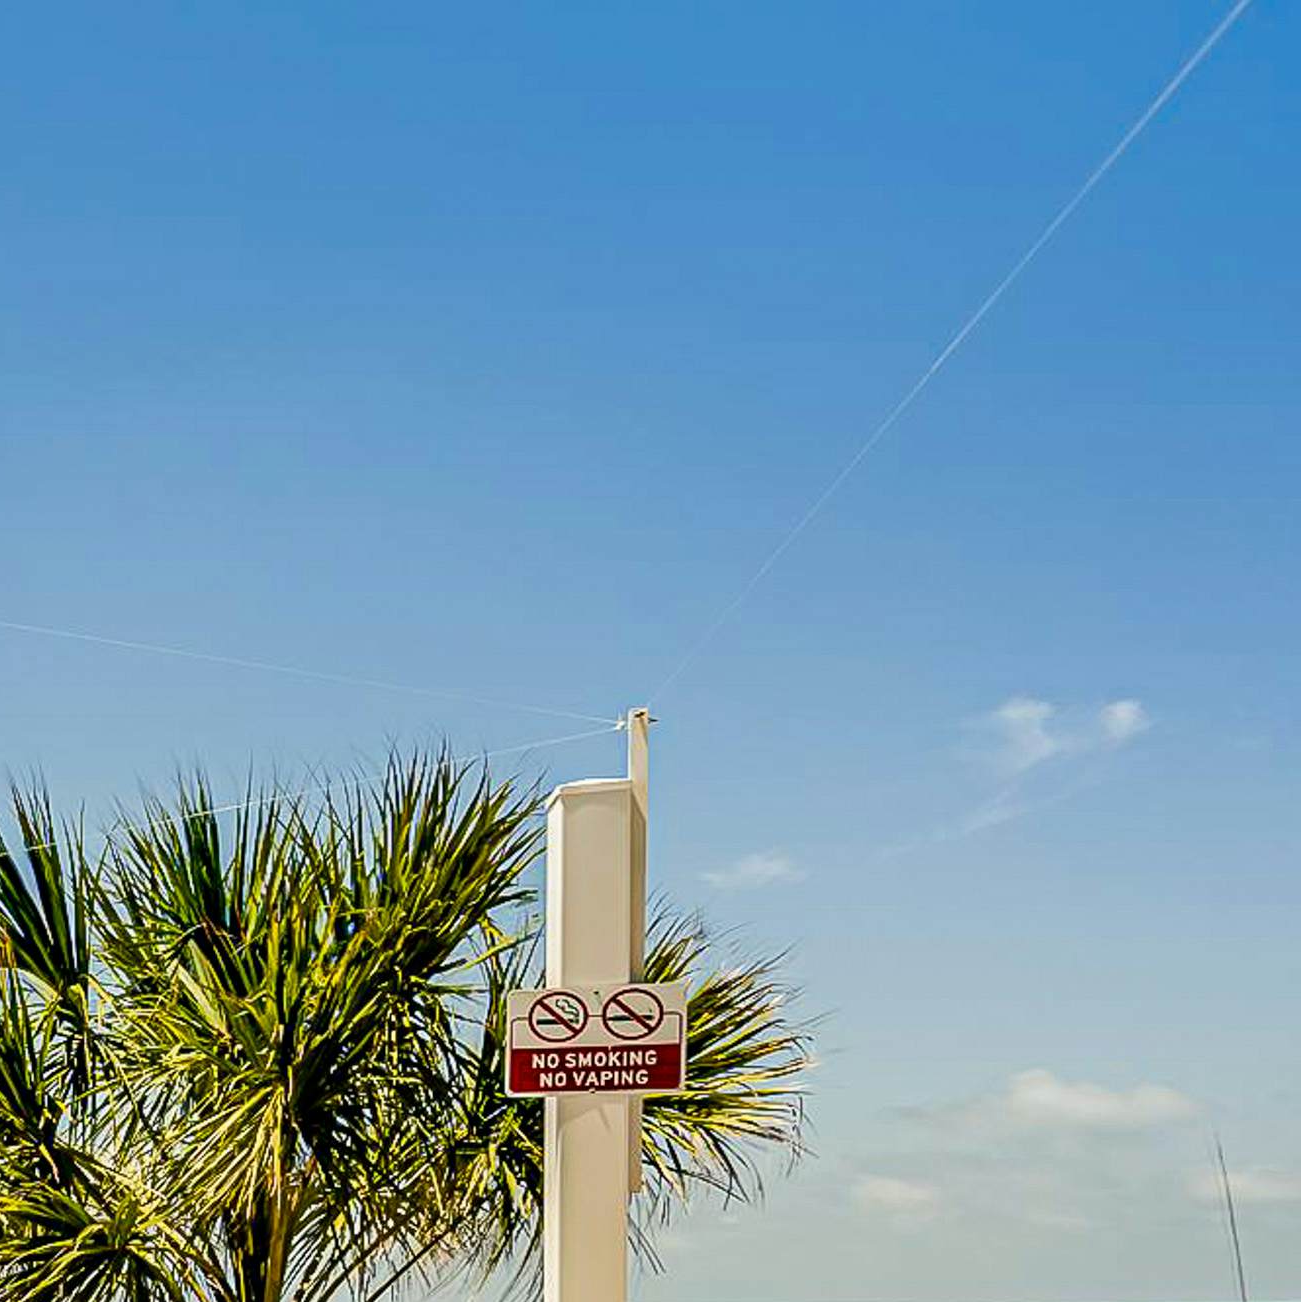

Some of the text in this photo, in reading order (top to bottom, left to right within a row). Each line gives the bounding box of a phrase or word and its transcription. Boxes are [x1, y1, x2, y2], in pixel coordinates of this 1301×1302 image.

[531, 1050, 657, 1069] NO SMOKING
[539, 1069, 649, 1087] NO VAPING
